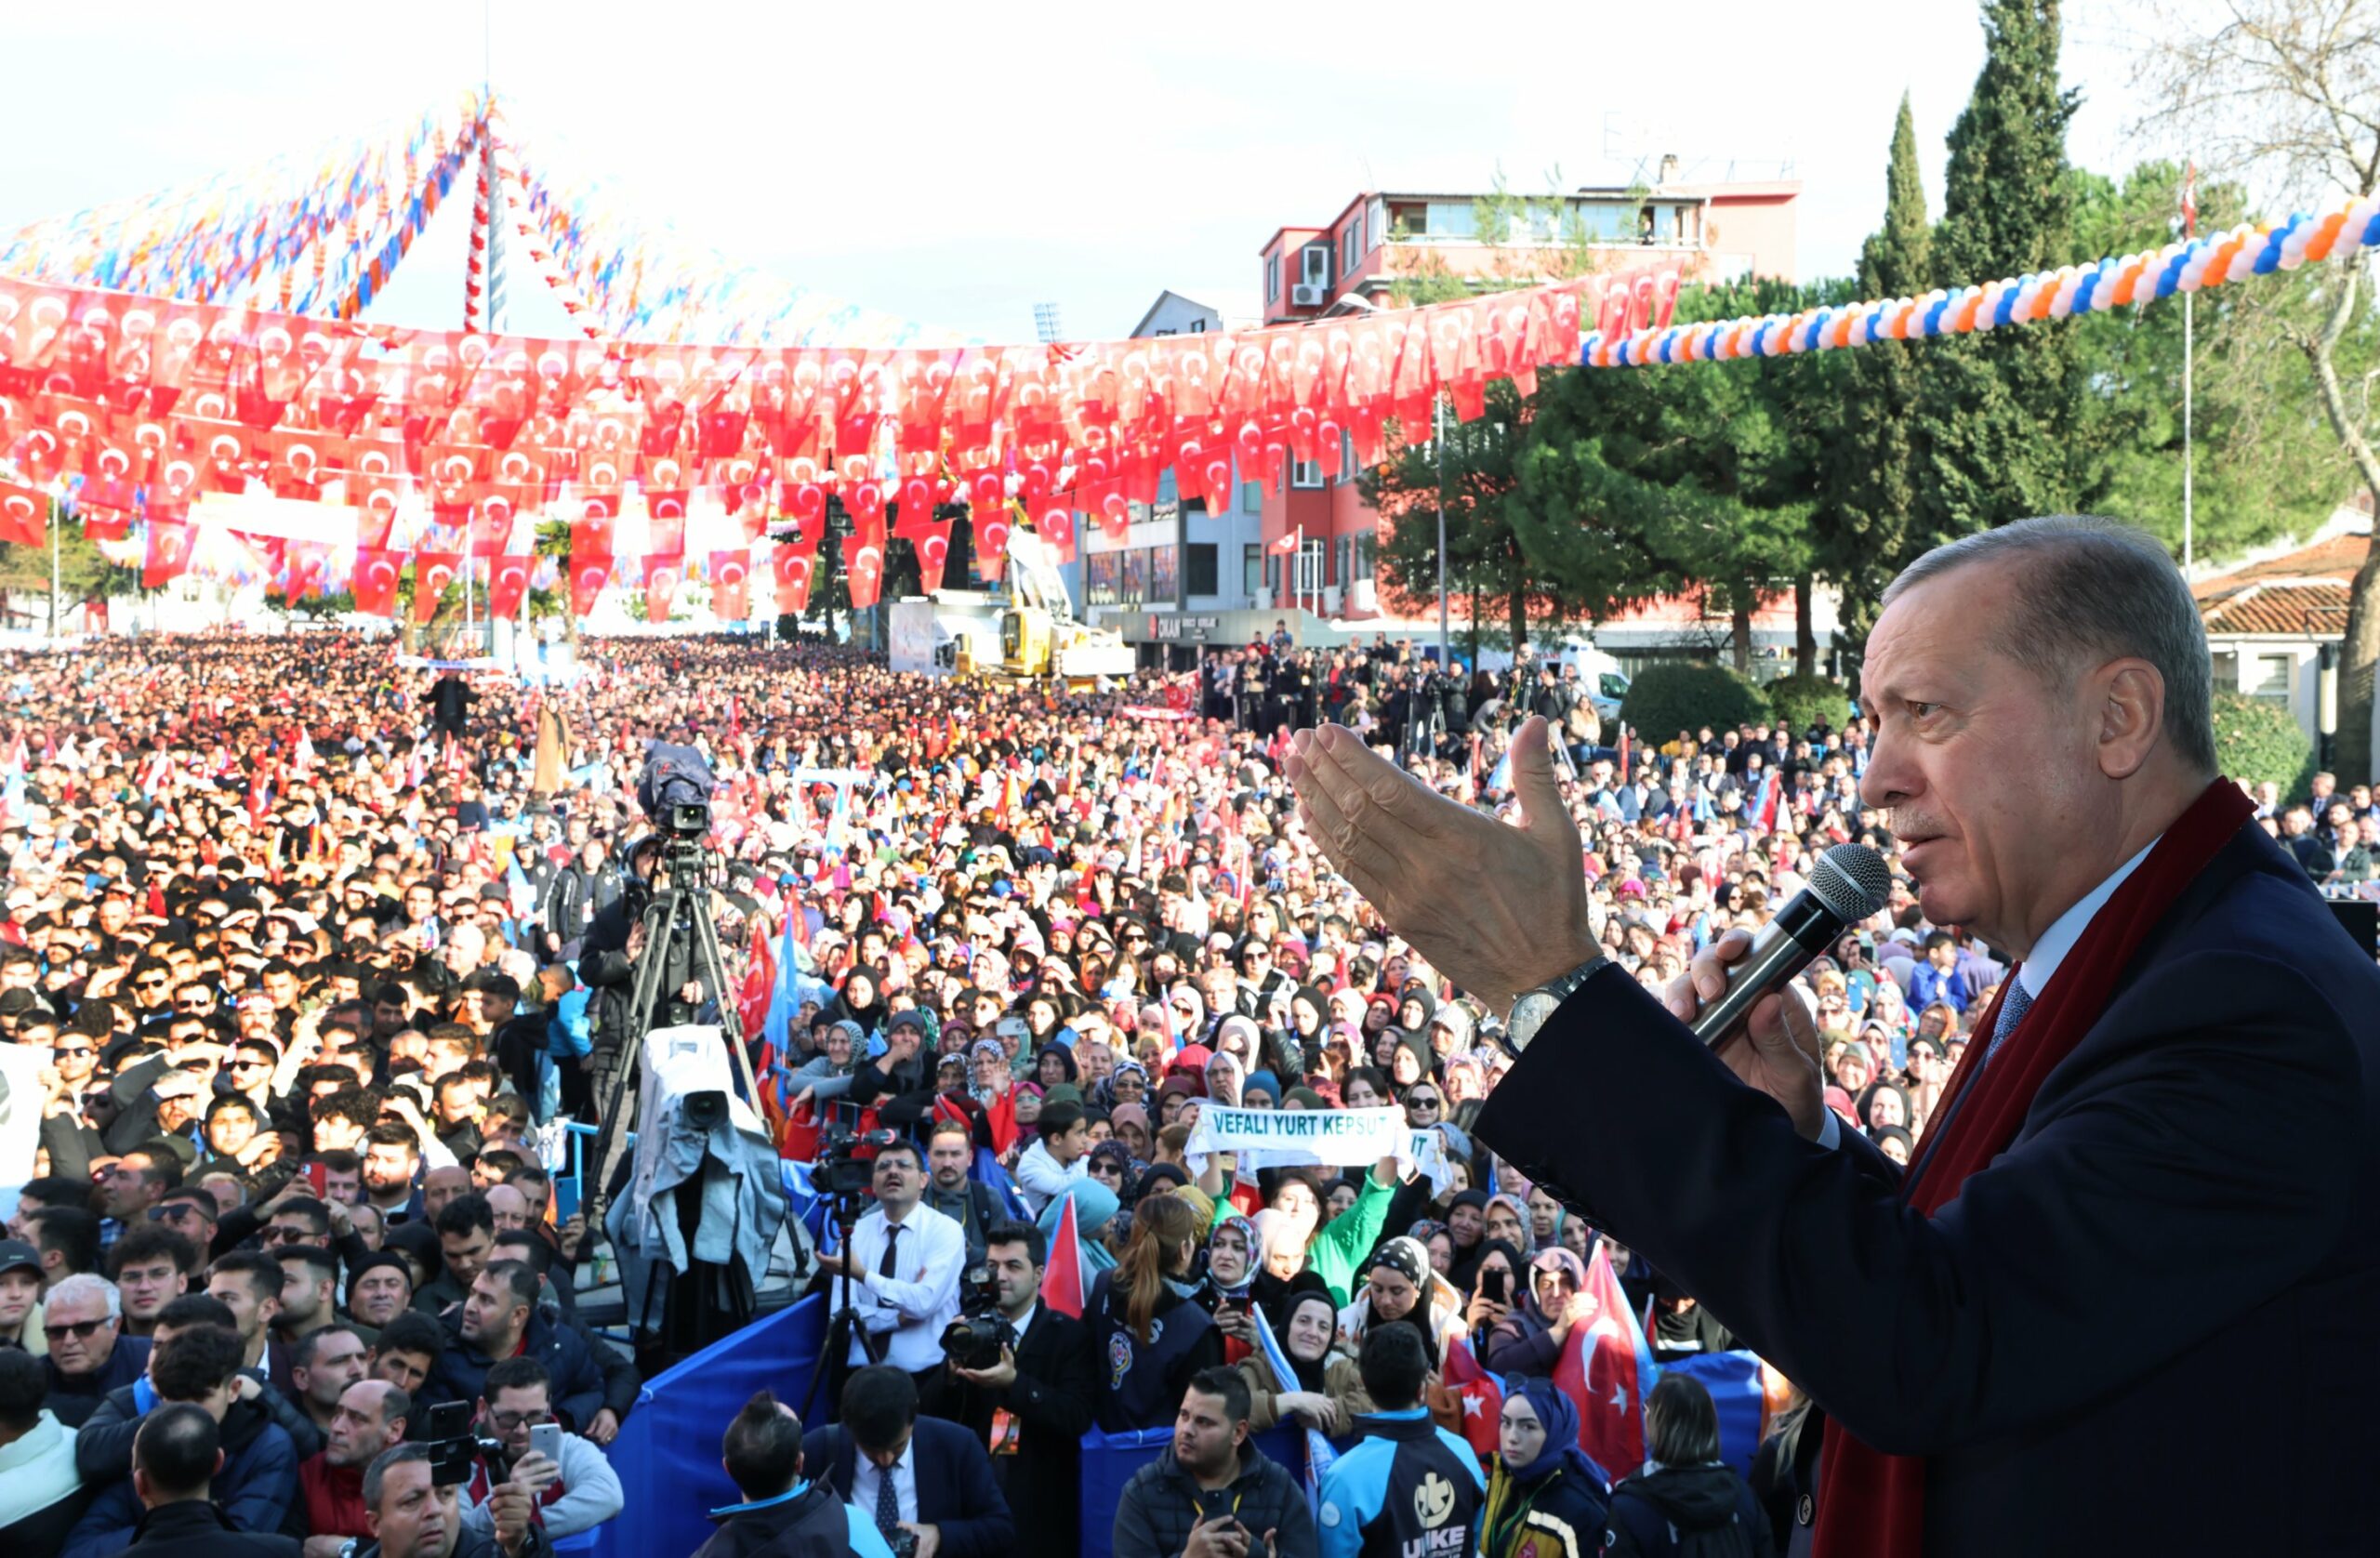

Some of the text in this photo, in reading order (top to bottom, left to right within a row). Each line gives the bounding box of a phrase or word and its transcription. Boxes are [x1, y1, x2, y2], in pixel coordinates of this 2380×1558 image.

[1213, 1113, 1387, 1135] VEFALI YURT KEPSUT
